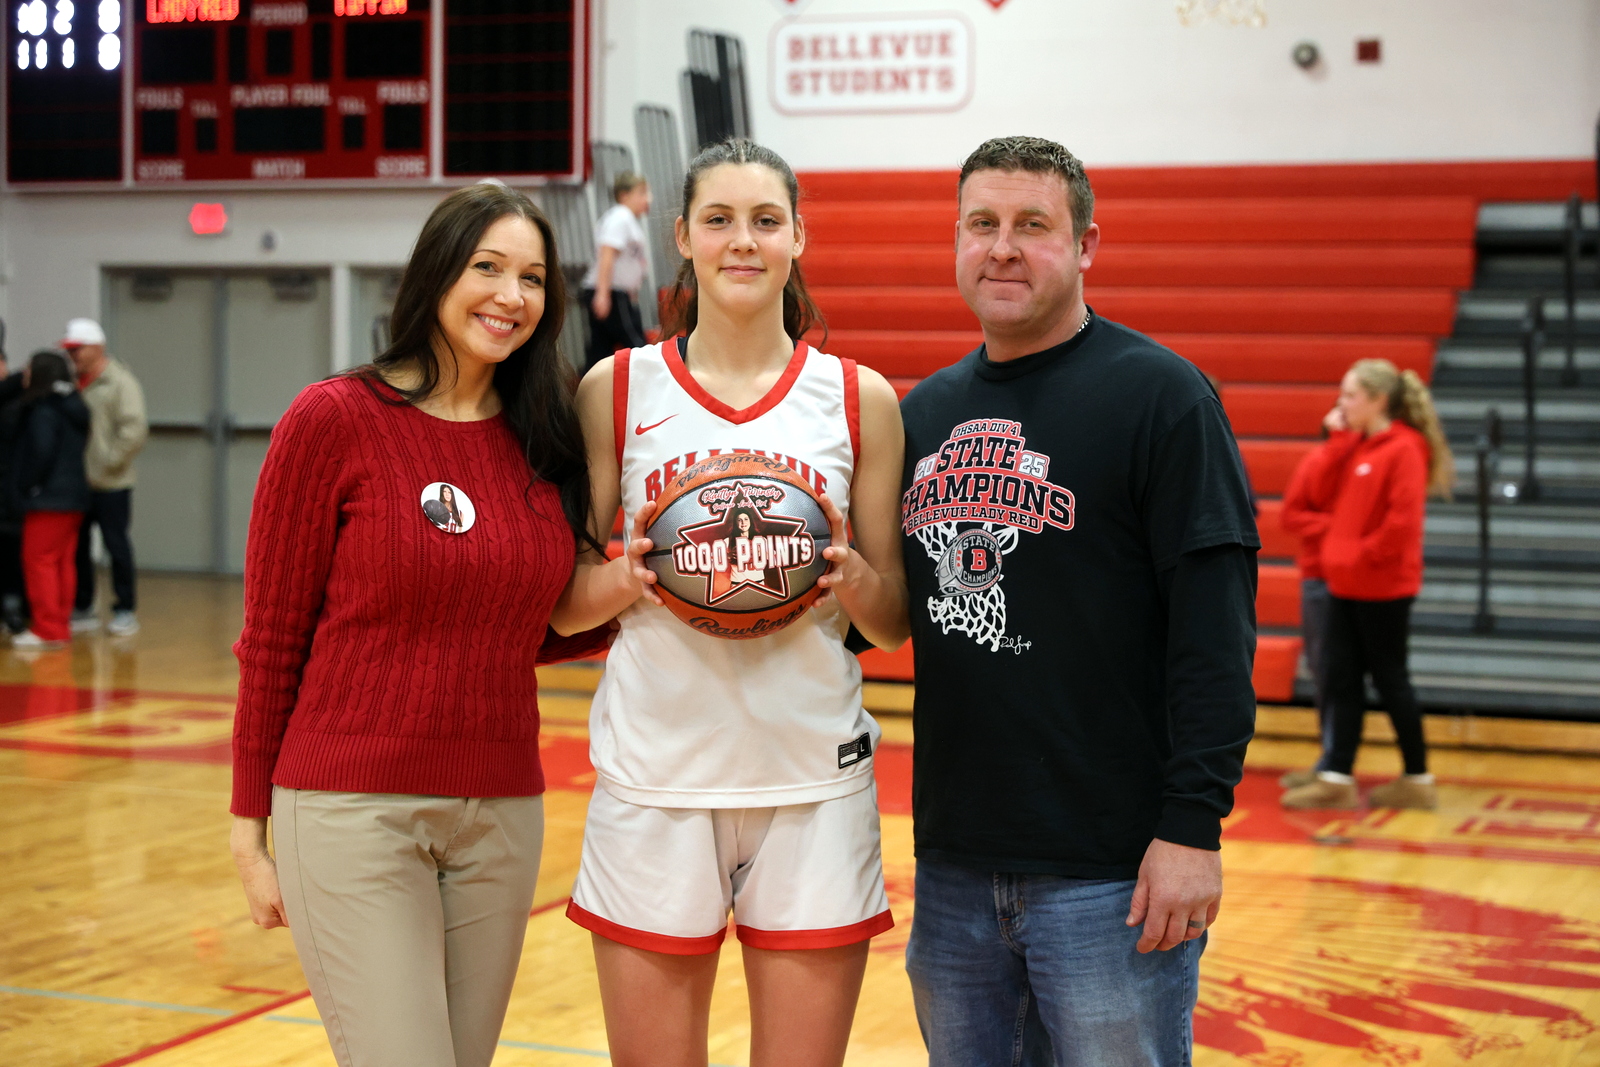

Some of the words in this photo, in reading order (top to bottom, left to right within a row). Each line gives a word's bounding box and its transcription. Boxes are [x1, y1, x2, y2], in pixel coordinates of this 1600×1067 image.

[788, 32, 954, 62] BELLEVUE
[377, 81, 428, 104] FOULS
[787, 66, 955, 96] STUDENTS
[136, 87, 183, 109] FOULS
[231, 84, 288, 107] PLAYER
[137, 159, 185, 178] SCORE
[252, 158, 305, 177] MATCH
[375, 156, 426, 177] SCORE
[954, 423, 987, 438] OHSAA
[989, 422, 1009, 433] DIV
[1010, 426, 1018, 436] 4
[936, 436, 1021, 474] STATE
[1018, 453, 1046, 478] 25
[915, 456, 936, 481] 20
[908, 506, 968, 531] BELLEVUE
[971, 507, 1005, 520] LADY
[1008, 511, 1039, 529] RED
[675, 539, 728, 573] 1000
[735, 535, 812, 573] POINTS
[963, 535, 996, 553] STATE
[970, 548, 987, 571] B
[689, 604, 807, 636] Rawlings
